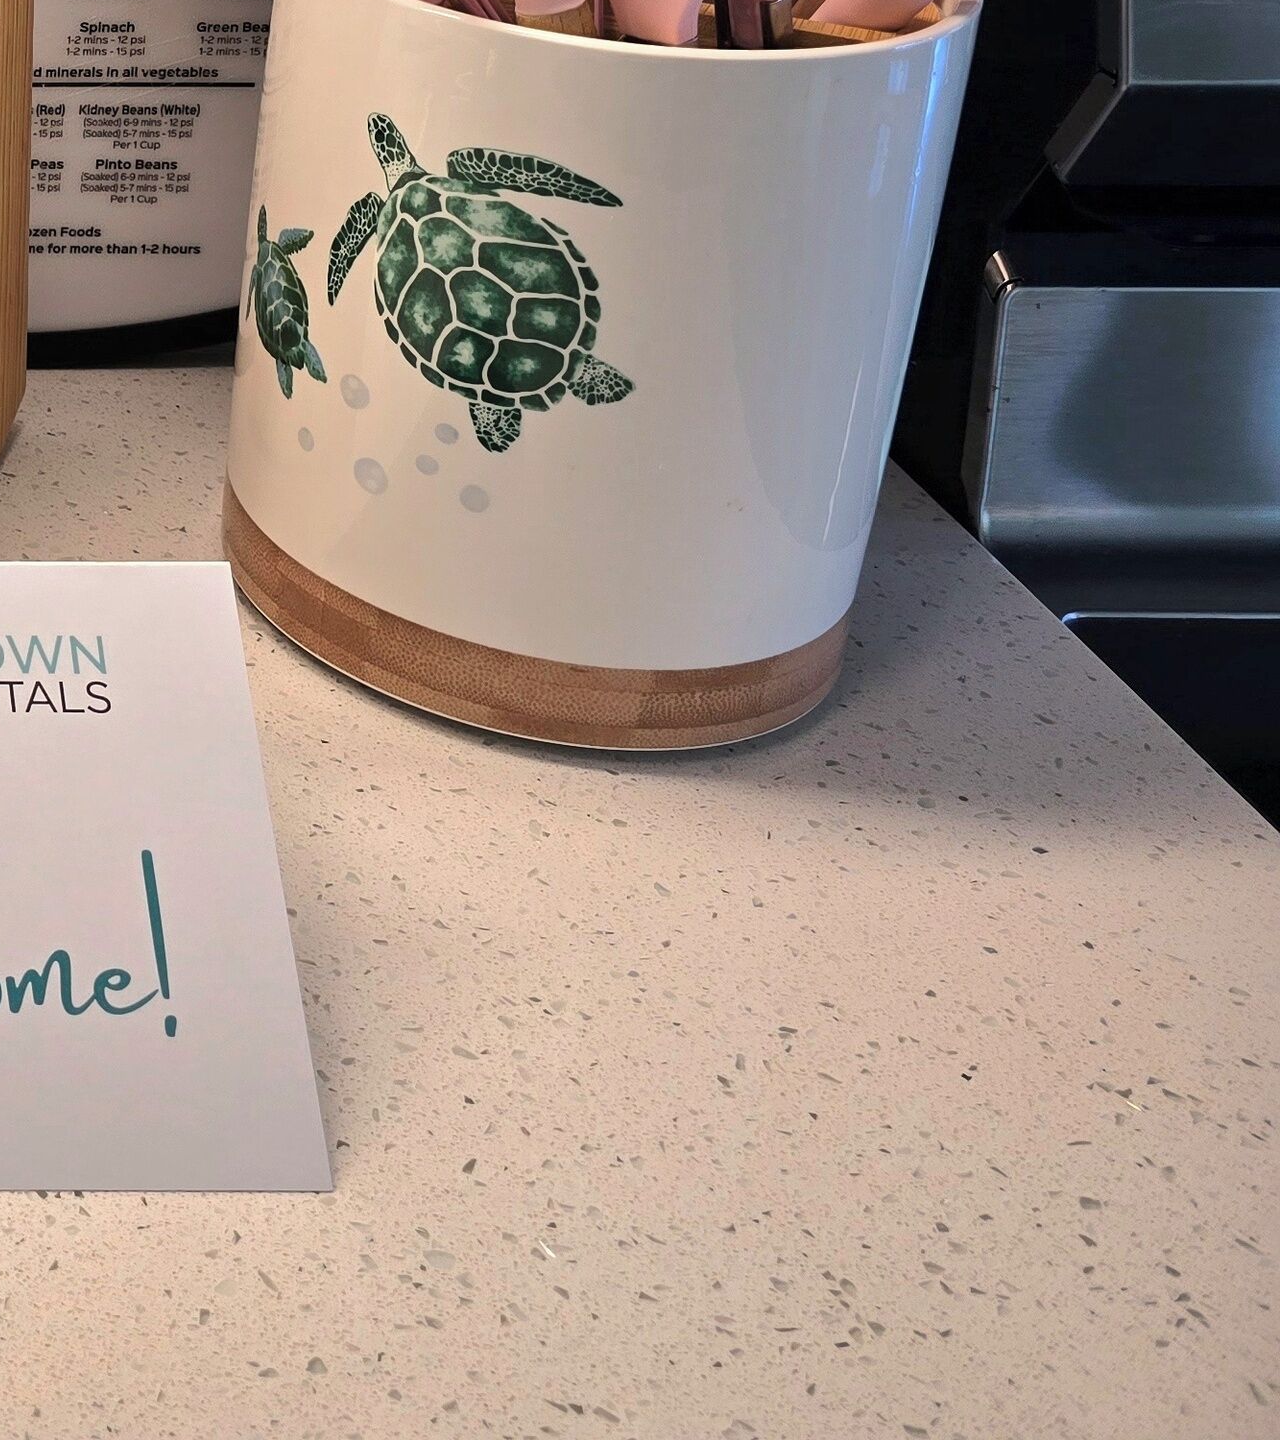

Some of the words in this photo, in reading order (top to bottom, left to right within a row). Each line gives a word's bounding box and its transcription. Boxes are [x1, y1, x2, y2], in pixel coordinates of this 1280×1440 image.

[80, 21, 135, 35] Spinach
[196, 22, 239, 33] Green
[242, 22, 269, 33] Bea
[67, 35, 81, 45] 1-2
[83, 35, 109, 44] mins
[117, 35, 128, 44] 12
[130, 35, 146, 46] psi
[45, 66, 103, 78] minerals
[106, 66, 119, 78] in
[122, 66, 138, 78] all
[141, 67, 218, 80] vegetables
[36, 104, 65, 117] (Red)
[79, 104, 120, 118] Kidney
[122, 104, 158, 115] Beans
[160, 104, 200, 117] (White)
[83, 117, 122, 128] (Soaked)
[123, 118, 139, 127] 6-9
[140, 118, 162, 127] mins
[169, 118, 179, 127] 12
[180, 118, 194, 128] psi
[83, 129, 121, 139] (Soaked)
[123, 129, 138, 138] 5-7
[139, 129, 160, 138] mins
[167, 129, 177, 138] 15
[178, 129, 193, 139] psi
[113, 140, 132, 149] Per
[139, 140, 161, 151] Cup
[31, 159, 64, 170] Peas
[95, 159, 132, 170] Pinto
[135, 159, 178, 170] Beans
[81, 172, 119, 182] (Soaked)
[120, 172, 136, 181] 6-9
[137, 172, 159, 181] mins
[166, 172, 175, 181] 12
[176, 173, 191, 183] psi
[110, 194, 128, 203] Per
[136, 195, 158, 205] Cup
[60, 226, 101, 237] Foods
[47, 243, 67, 254] for
[69, 245, 103, 254] more
[106, 243, 138, 254] than
[141, 244, 159, 254] 1-2
[162, 244, 201, 254] hours
